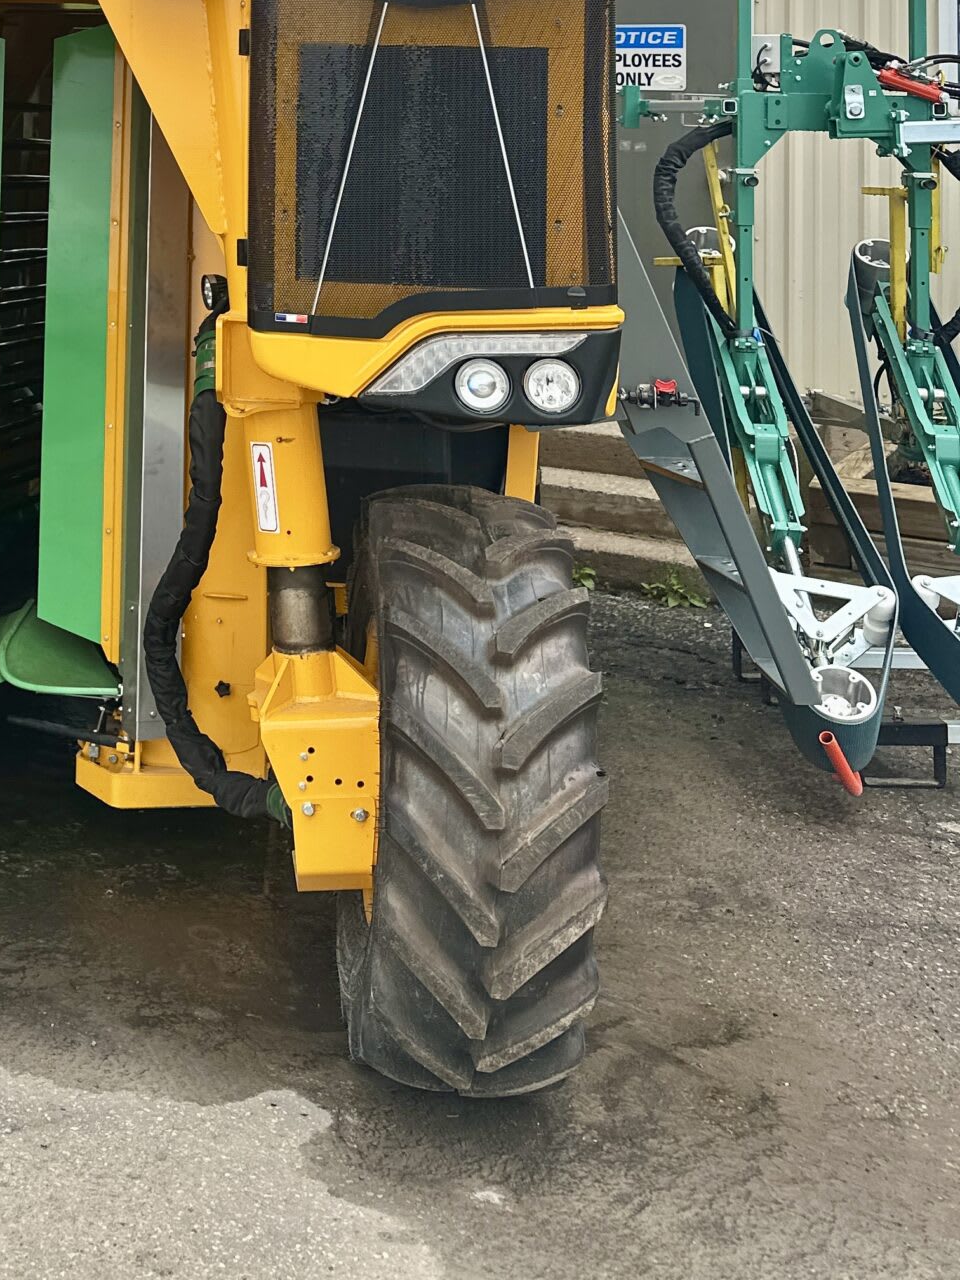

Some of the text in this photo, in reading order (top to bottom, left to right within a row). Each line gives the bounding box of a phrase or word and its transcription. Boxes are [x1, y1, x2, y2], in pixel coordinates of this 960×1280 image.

[615, 31, 678, 45] OTICE
[615, 53, 682, 68] PLOYEES
[615, 72, 655, 87] ONLY
